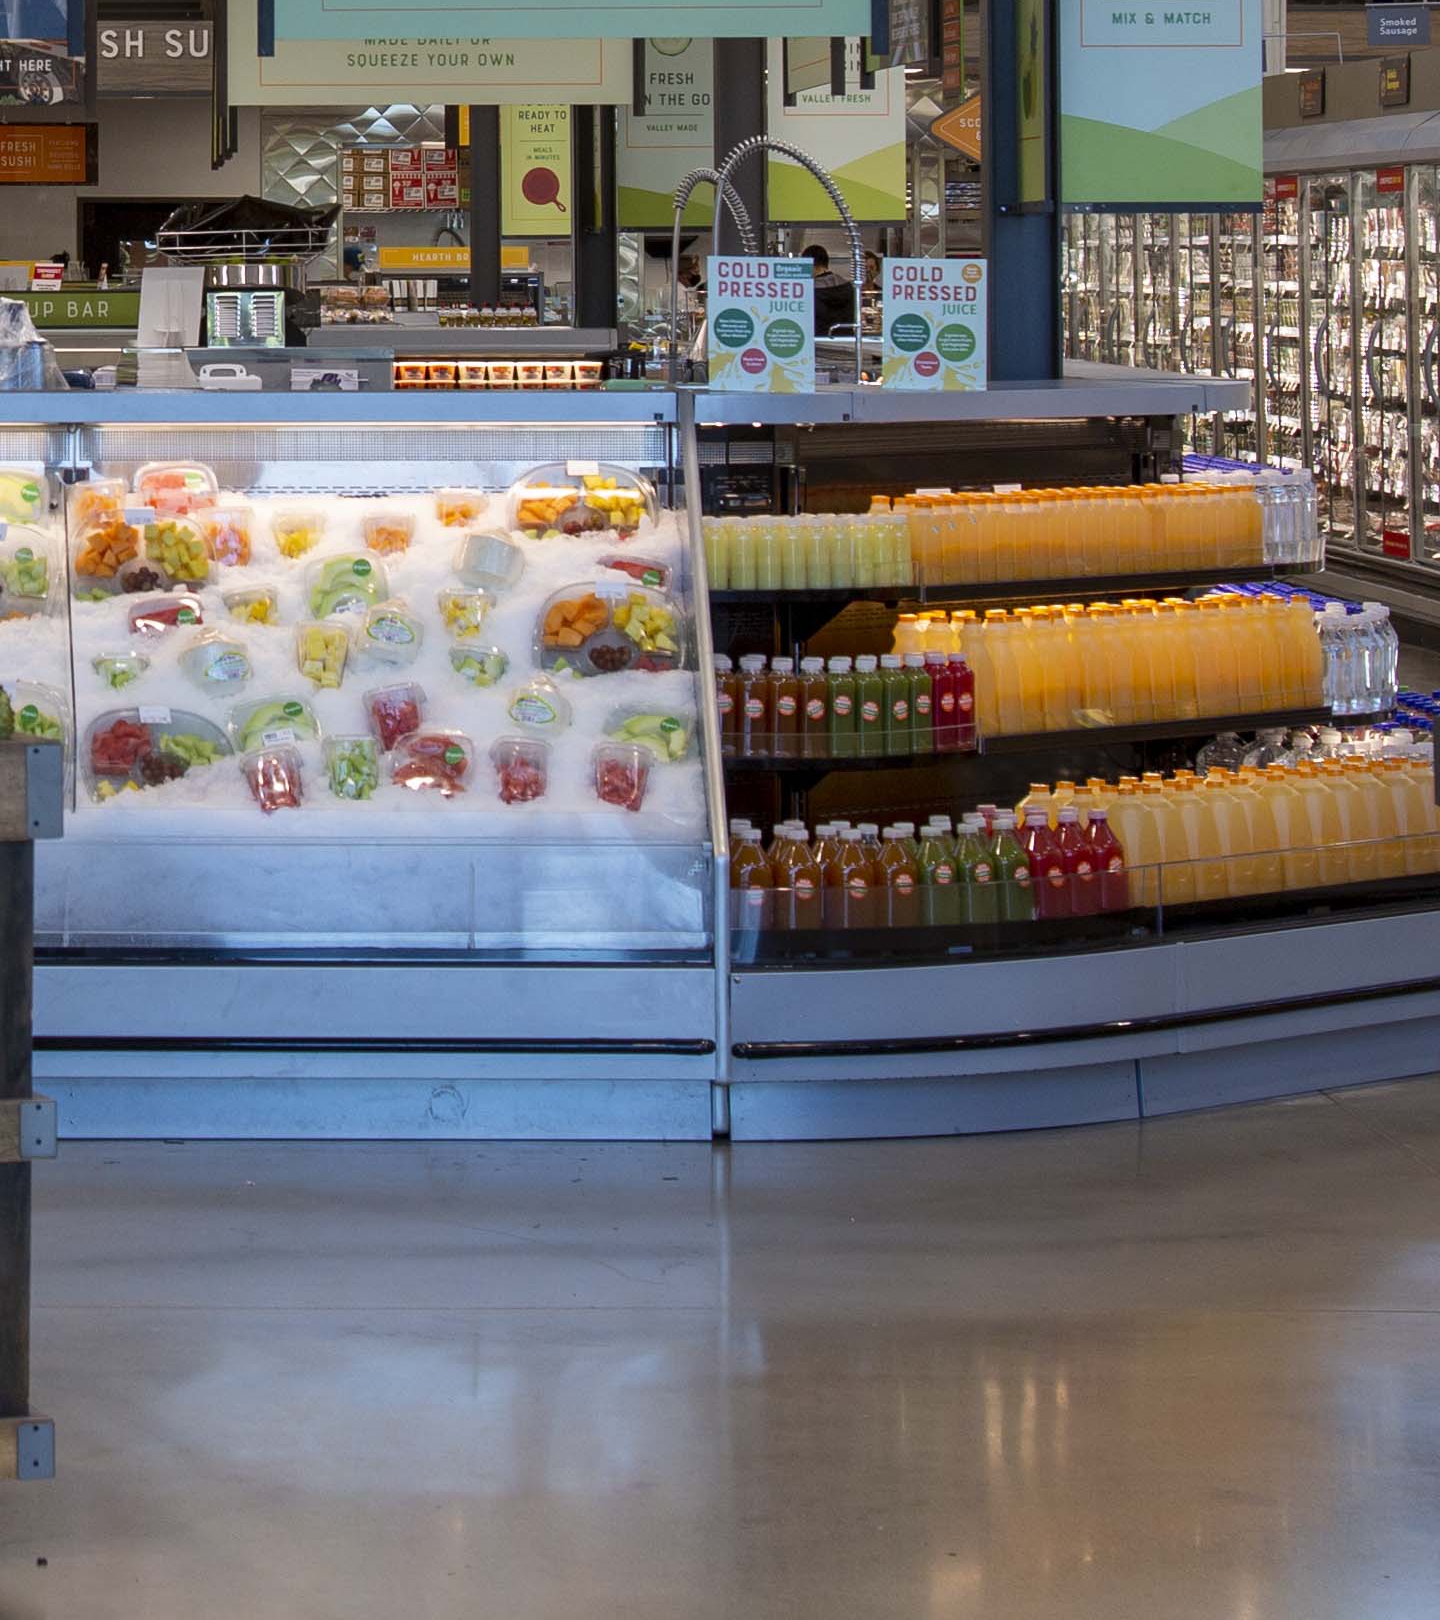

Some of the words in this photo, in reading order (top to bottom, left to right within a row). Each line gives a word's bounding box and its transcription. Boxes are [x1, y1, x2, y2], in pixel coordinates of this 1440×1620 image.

[1112, 12, 1137, 25] MIX
[1145, 12, 1155, 24] &
[1164, 12, 1212, 24] MATCH
[1380, 18, 1417, 26] Smoked
[1379, 27, 1418, 36] Sausage
[18, 58, 52, 74] HERE
[347, 54, 419, 68] SQUEEZE
[427, 54, 469, 66] YOUR
[478, 54, 516, 66] OWN
[650, 72, 695, 85] FRESH
[659, 93, 686, 106] THE
[691, 93, 711, 106] GO
[518, 110, 551, 121] READY
[555, 110, 567, 121] TO
[530, 123, 555, 134] HEAT
[646, 124, 673, 132] VALLEY
[677, 124, 698, 132] MADE
[0, 141, 36, 152] FRESH
[0, 156, 36, 166] SUSHI
[718, 262, 769, 278] COLD
[892, 266, 943, 282] COLD
[718, 282, 804, 298] PRESSED
[892, 285, 976, 302] PRESSED
[67, 301, 109, 317] BAR
[769, 300, 805, 313] JUICE
[942, 303, 976, 315] JUICE
